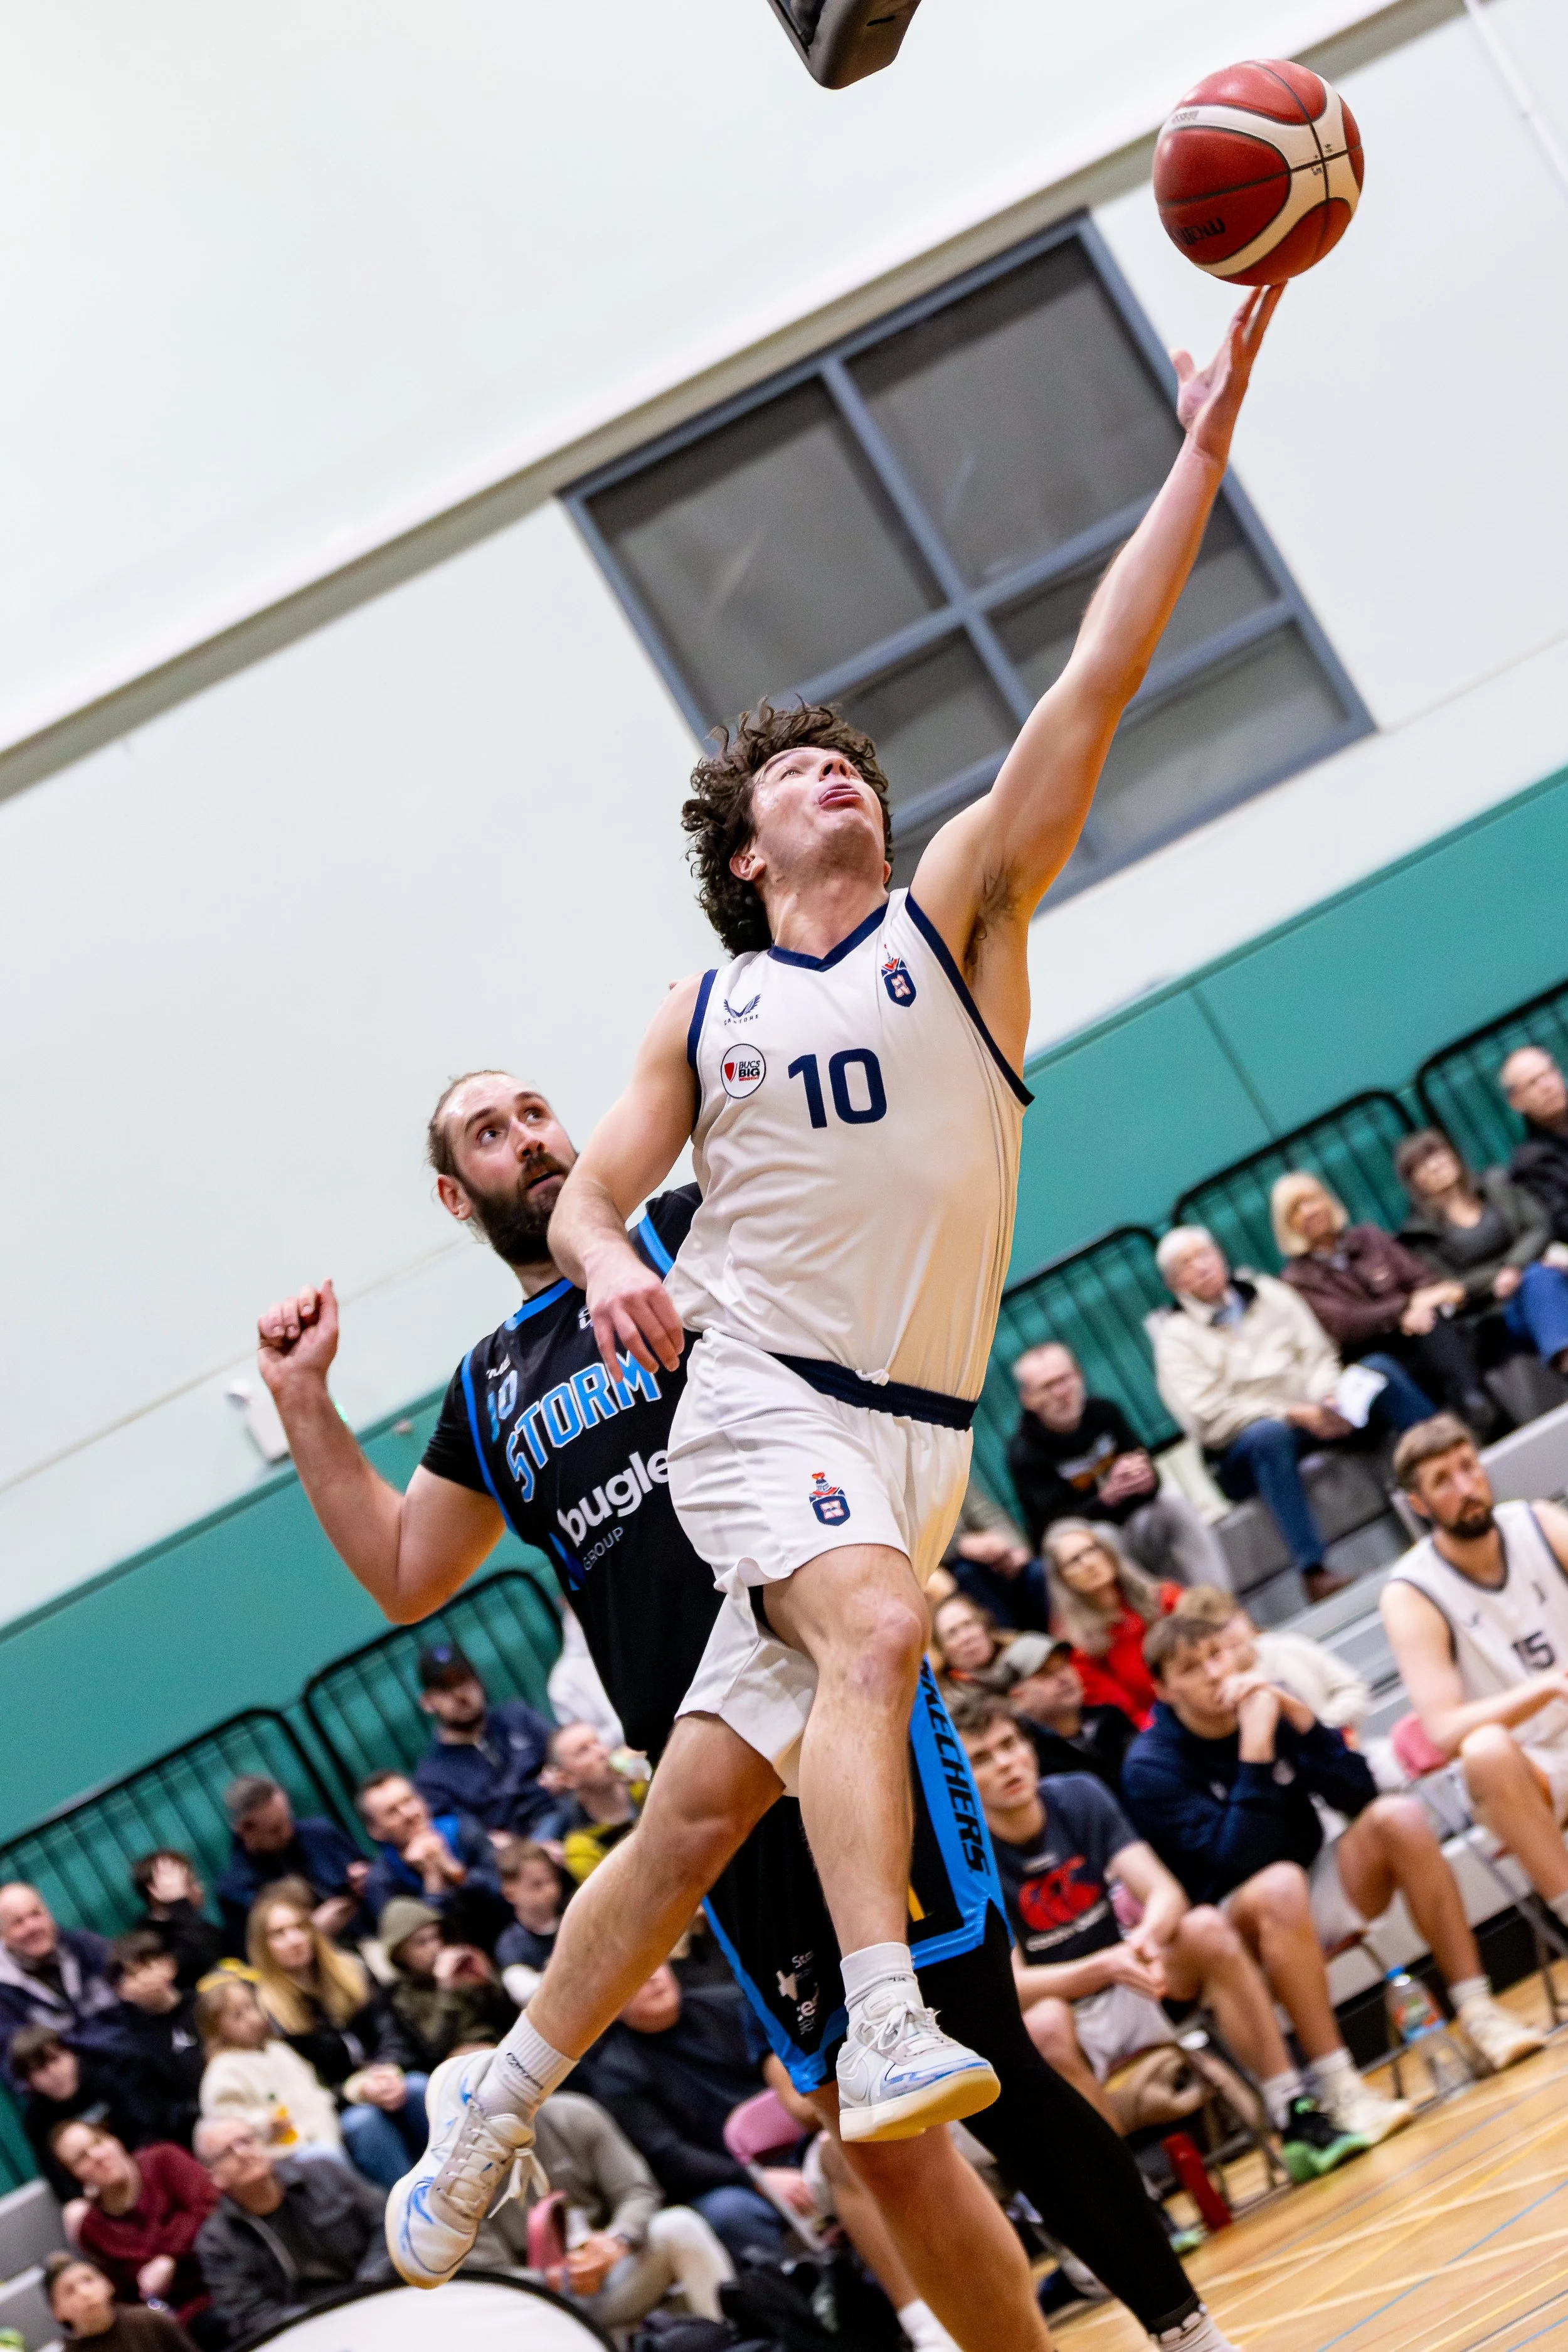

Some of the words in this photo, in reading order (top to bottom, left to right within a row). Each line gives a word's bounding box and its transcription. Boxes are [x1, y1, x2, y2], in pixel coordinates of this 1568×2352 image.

[739, 1060, 760, 1069] BUCS
[739, 1068, 760, 1078] BIG
[788, 1048, 887, 1129] 10
[506, 1350, 662, 1503] STORM
[556, 1449, 669, 1548] bugle
[583, 1526, 624, 1571] GROUP
